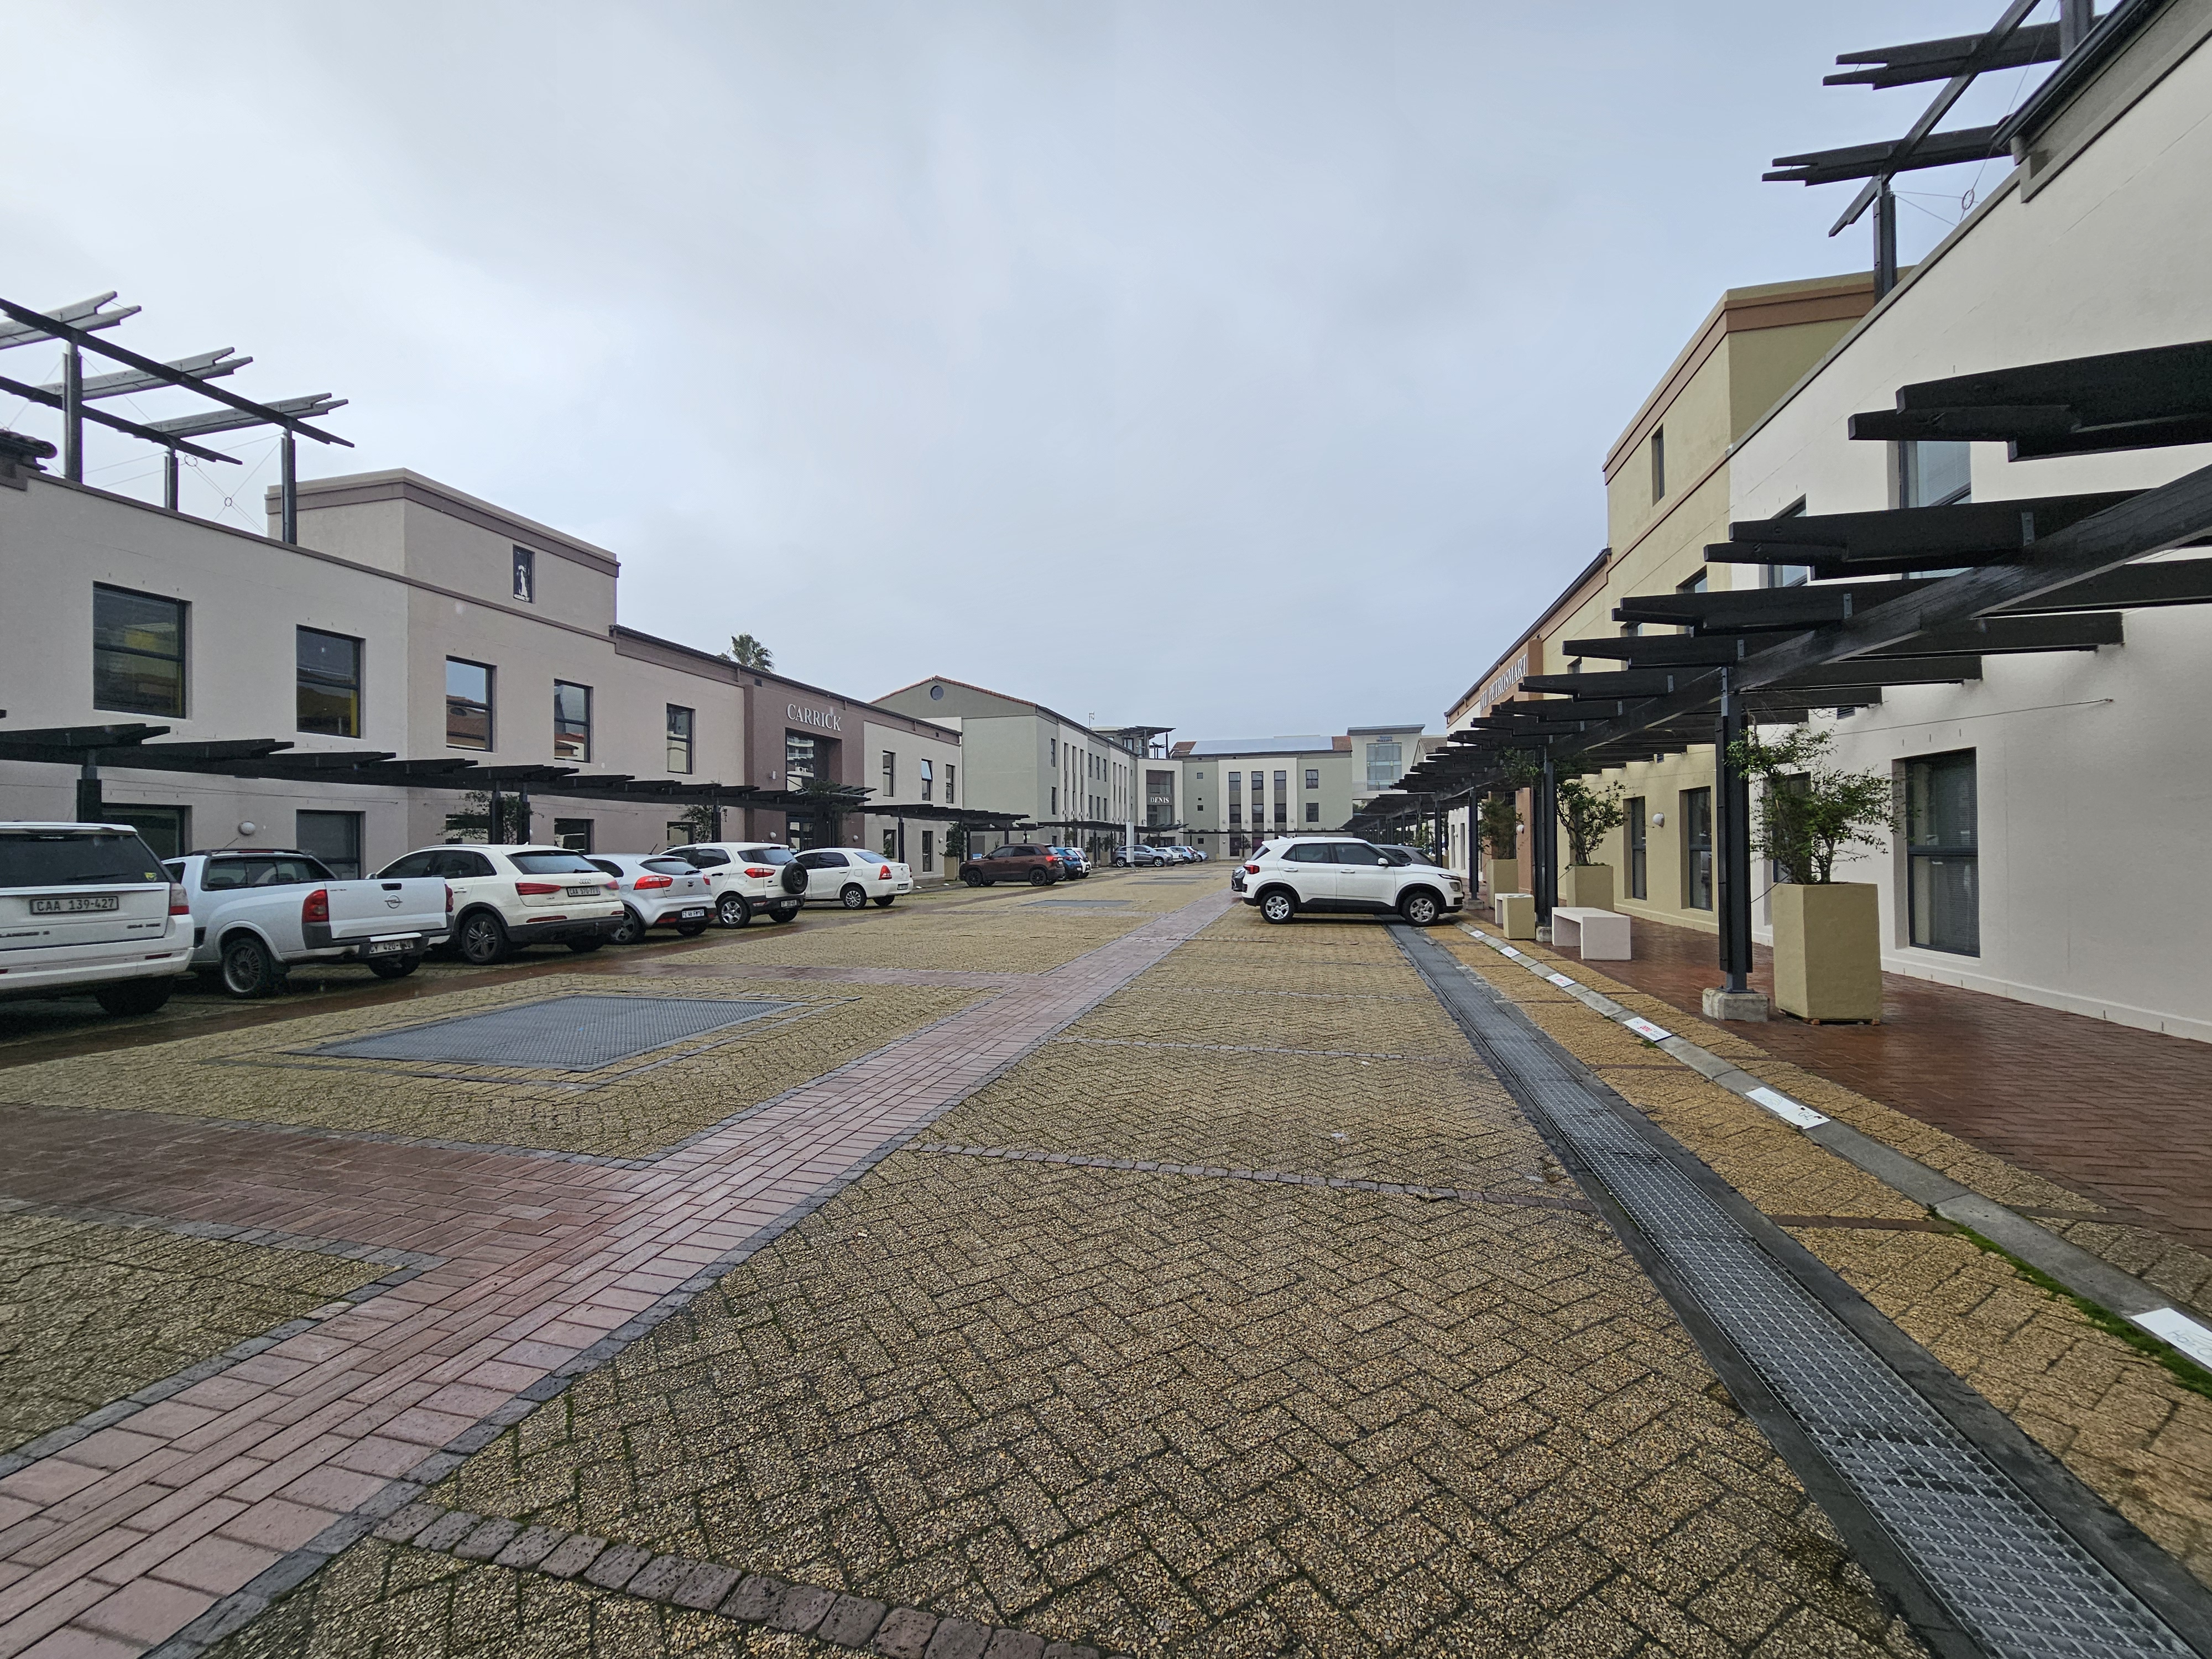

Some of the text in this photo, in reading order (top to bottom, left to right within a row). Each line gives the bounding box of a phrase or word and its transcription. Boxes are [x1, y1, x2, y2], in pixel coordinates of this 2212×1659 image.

[1489, 654, 1526, 703] PETROSMART
[787, 703, 841, 732] CARRICK
[36, 898, 114, 911] CAA 139-427
